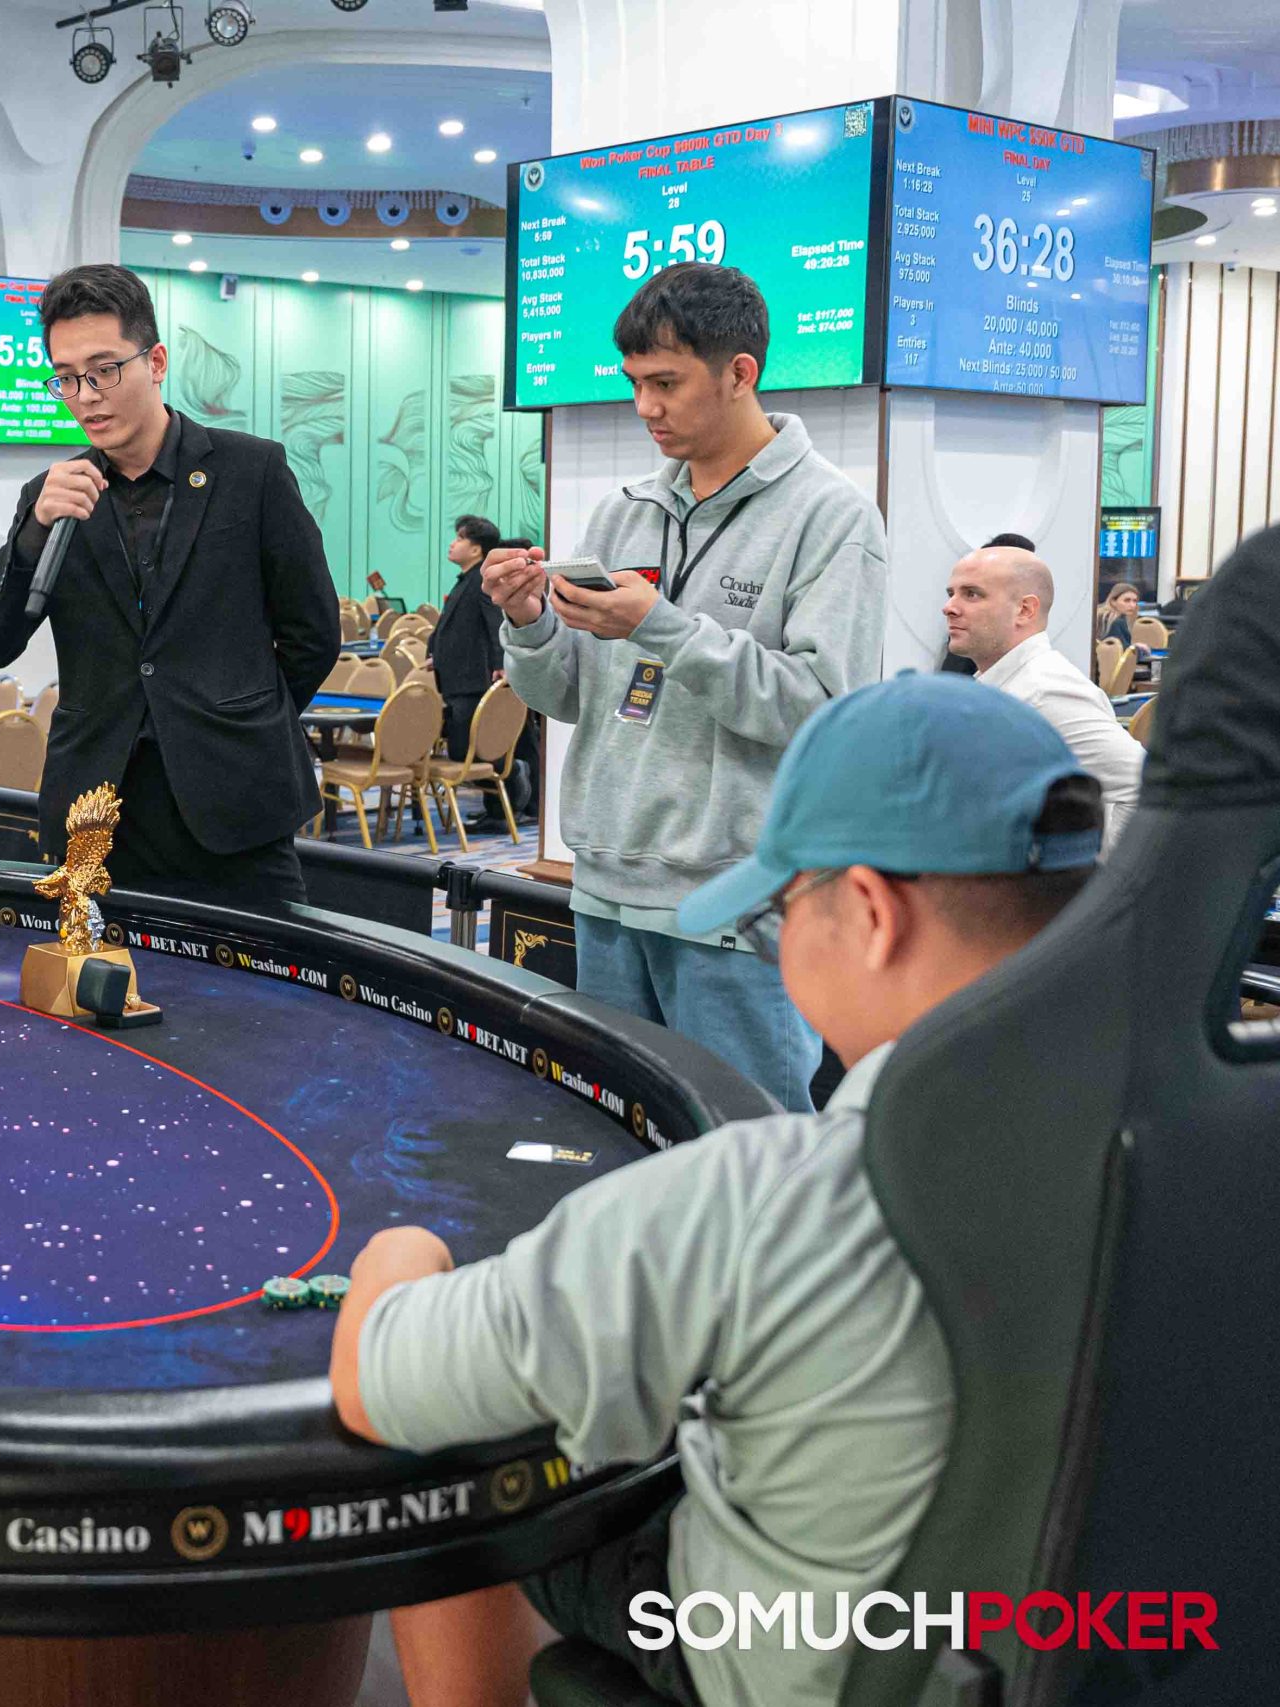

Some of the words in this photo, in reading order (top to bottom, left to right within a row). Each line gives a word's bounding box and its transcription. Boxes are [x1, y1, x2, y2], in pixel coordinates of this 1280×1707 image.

[967, 113, 995, 137] MINI
[998, 120, 1027, 143] WPC
[1060, 133, 1085, 155] GTD
[580, 156, 606, 169] Won
[609, 149, 642, 164] Poker
[646, 144, 670, 159] Cup
[713, 128, 741, 147] GTD
[745, 125, 770, 141] Day
[638, 164, 672, 179] FINAL
[677, 156, 715, 173] TABLE
[896, 159, 916, 175] Next
[916, 162, 942, 178] Break
[1003, 150, 1031, 169] FINAL
[1033, 155, 1051, 173] DAY
[662, 182, 688, 196] Level
[1016, 173, 1037, 188] Level
[1021, 190, 1031, 203] 25
[521, 219, 540, 231] Next
[542, 215, 566, 229] Break
[895, 205, 915, 219] Total
[916, 207, 940, 223] Stack
[622, 219, 726, 280] 5:59
[791, 241, 835, 258] Elapsed
[837, 239, 865, 252] Time
[972, 213, 1075, 282] 36:28
[521, 256, 540, 268] Total
[542, 253, 565, 266] Stack
[894, 250, 911, 267] Avg
[912, 252, 936, 266] Stack
[898, 269, 931, 284] 975,000
[522, 295, 537, 306] Avg
[540, 291, 563, 304] Stack
[893, 295, 924, 312] Players
[926, 299, 934, 312] In
[1006, 294, 1040, 314] Blinds
[910, 314, 916, 326] 3
[983, 315, 1017, 333] 20,000
[1026, 320, 1058, 338] 40,000
[521, 331, 551, 343] Players
[553, 330, 562, 340] In
[897, 335, 927, 350] Entries
[538, 344, 544, 354] 2
[988, 338, 1016, 356] Ante:
[1019, 342, 1052, 360] 40,000
[526, 362, 556, 374] Entries
[904, 353, 919, 366] 117
[960, 358, 980, 373] Next
[594, 364, 618, 377] Next
[20, 914, 52, 931] Won
[128, 931, 209, 959] M9BET.NET
[237, 952, 328, 989] Wcasino9.COM
[359, 984, 389, 1008] Won
[391, 995, 432, 1024] Casino
[457, 1019, 528, 1066] M9BET.NET
[551, 1061, 625, 1118] Wcasino9.COM
[646, 1118, 666, 1151] Won
[243, 1481, 474, 1548] M9BET.NET
[4, 1516, 151, 1555] Casino
